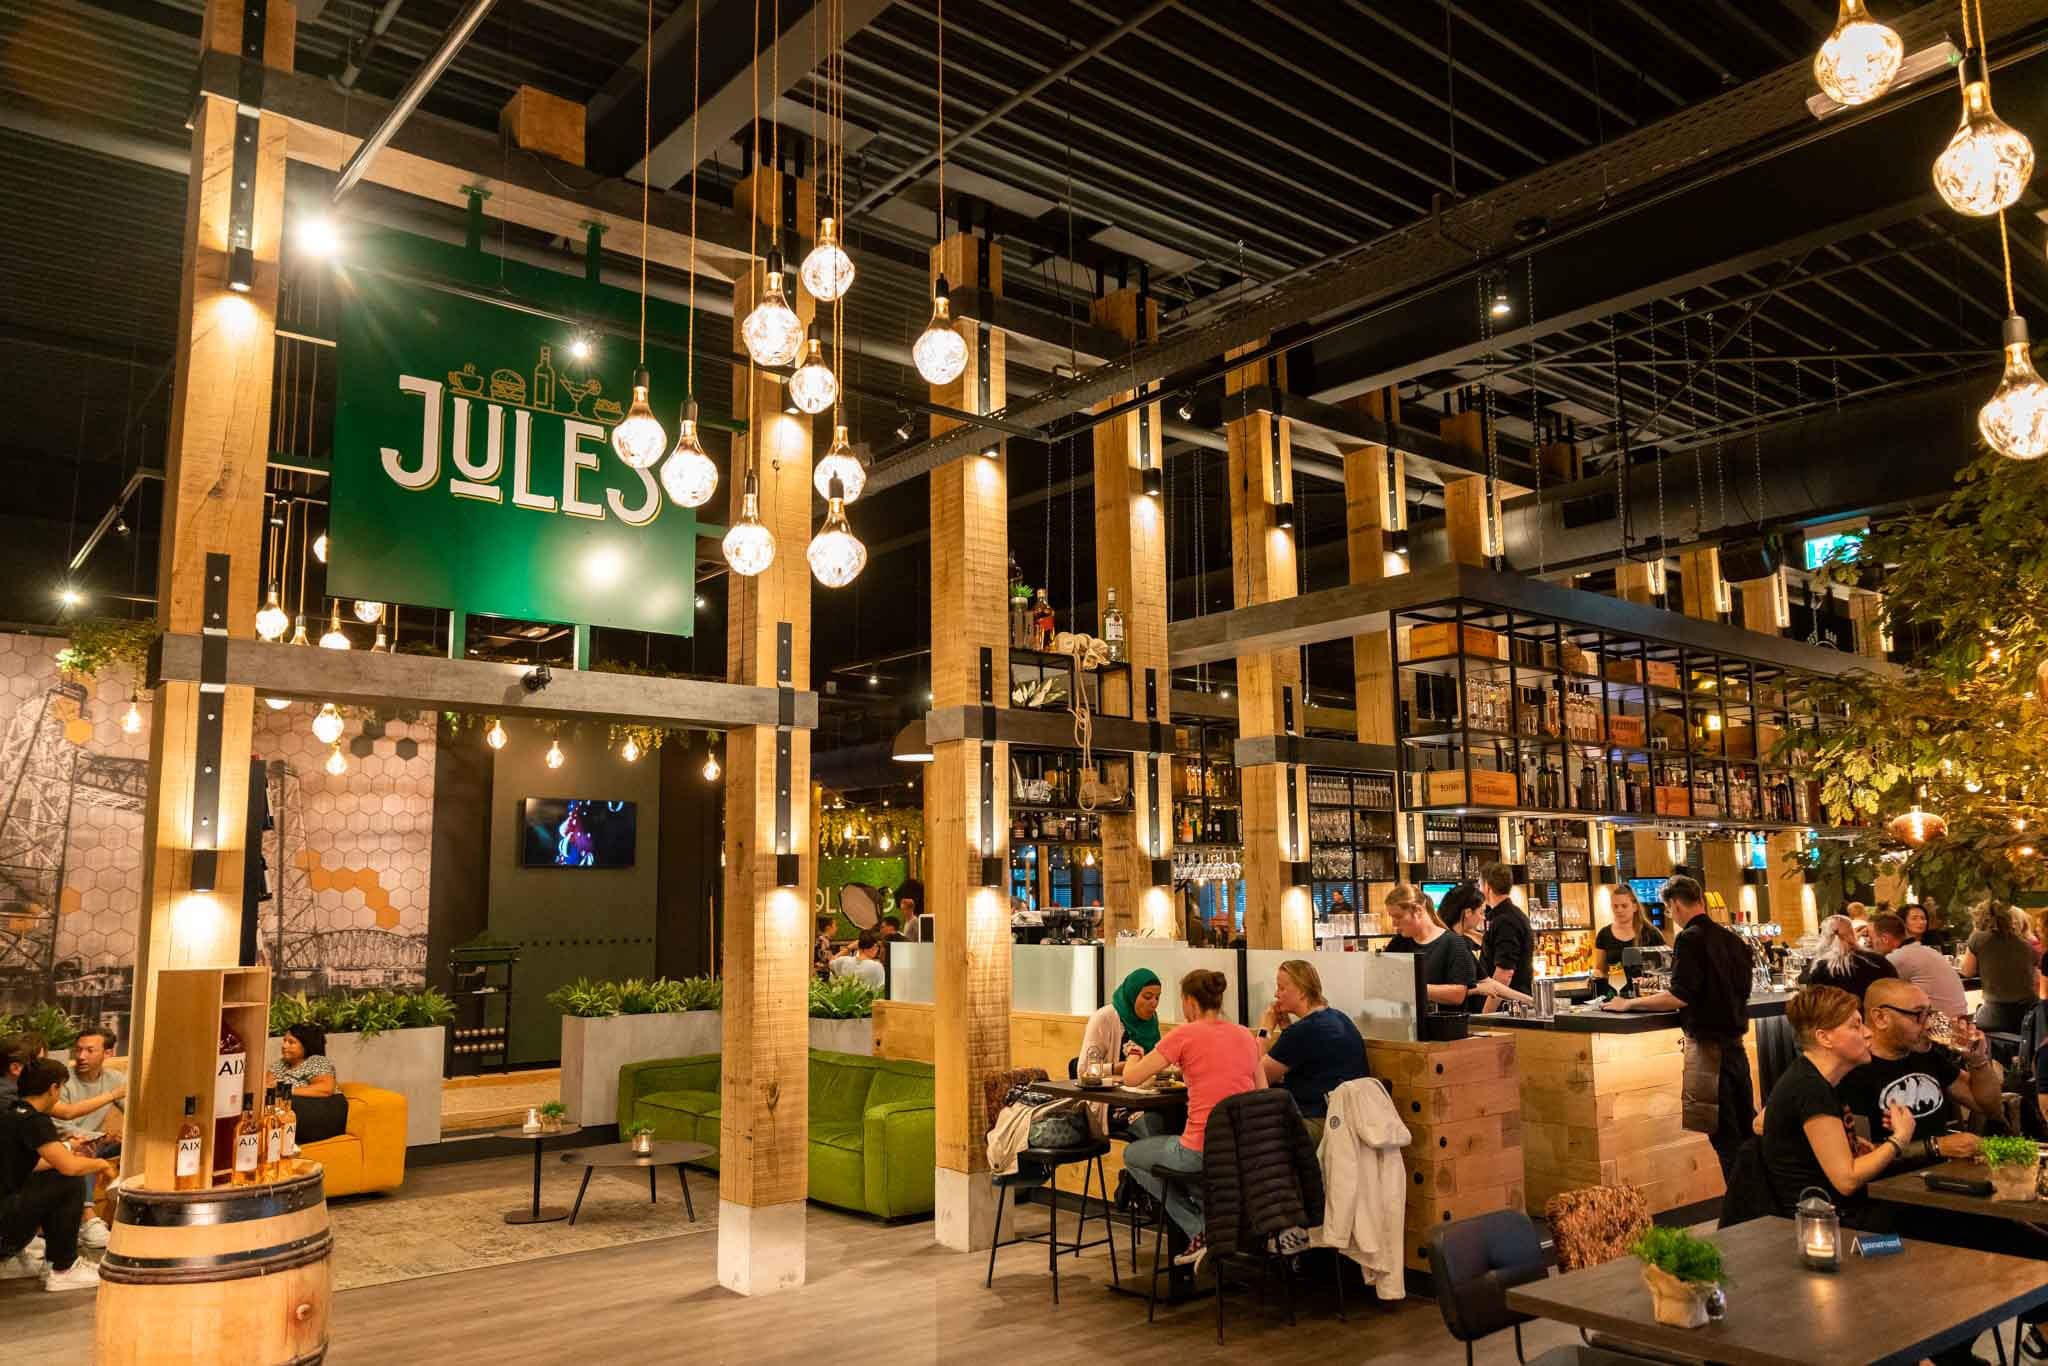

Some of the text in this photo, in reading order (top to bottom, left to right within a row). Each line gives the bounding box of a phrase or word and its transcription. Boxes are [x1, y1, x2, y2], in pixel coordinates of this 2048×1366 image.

[380, 374, 662, 526] JULES
[218, 1059, 246, 1076] AIX
[180, 1140, 200, 1151] AIX
[239, 1136, 258, 1147] AIX
